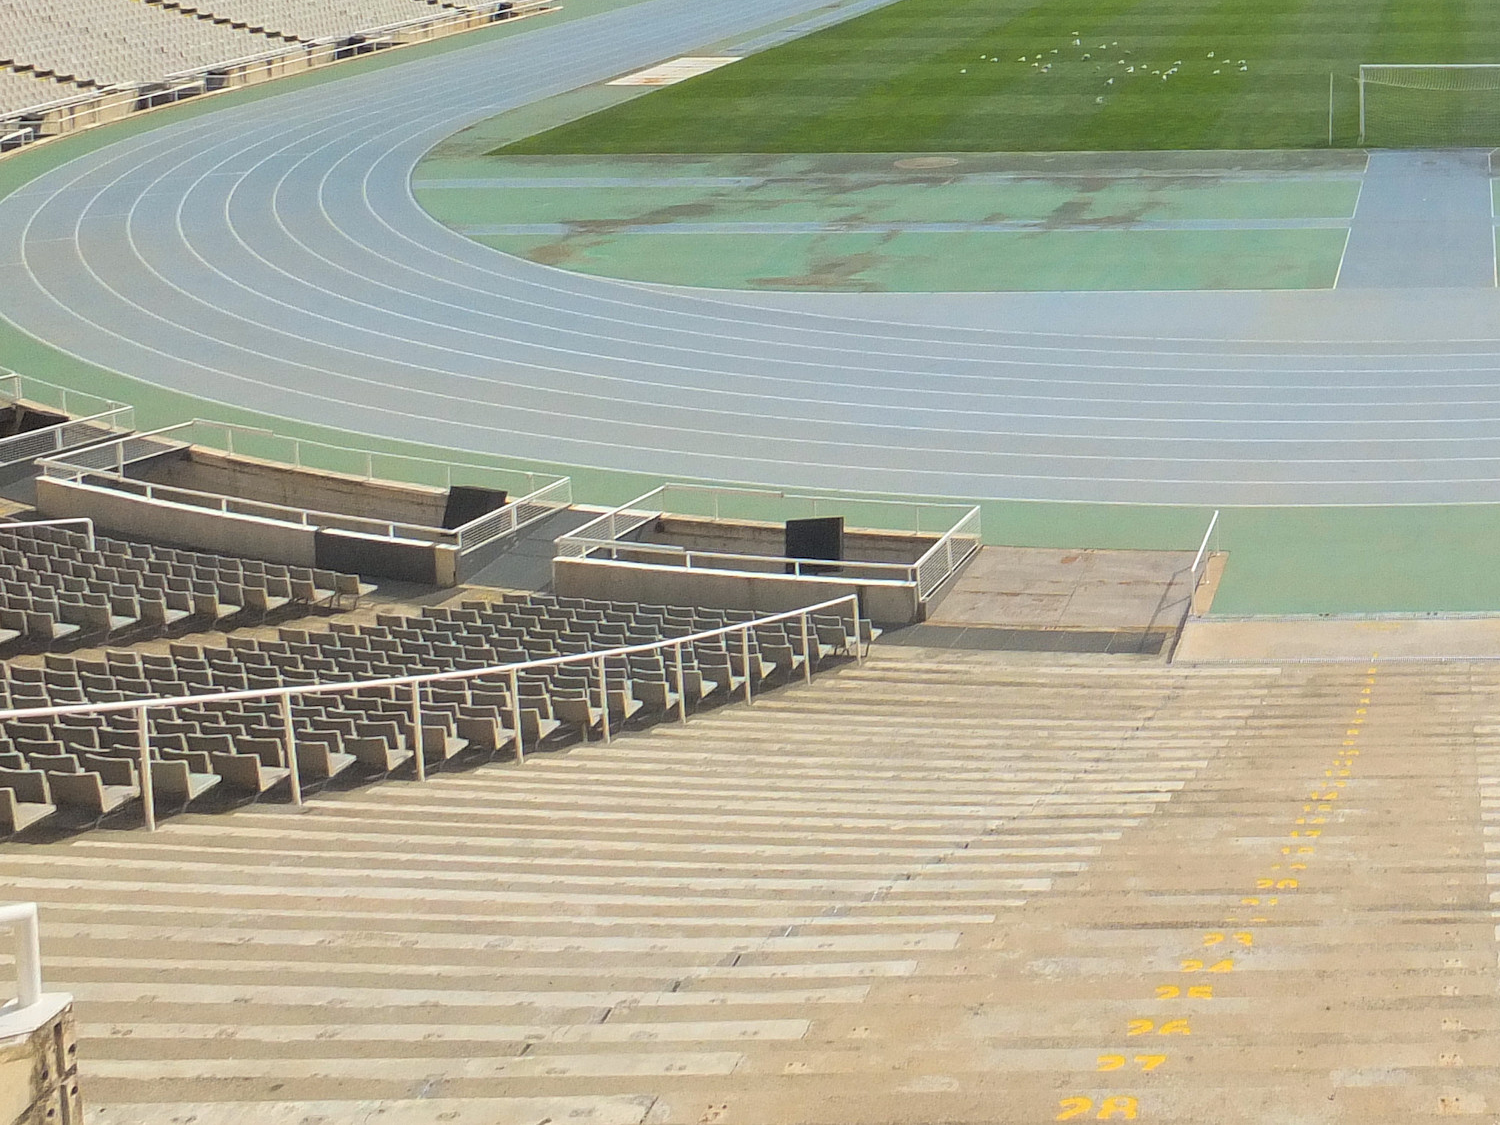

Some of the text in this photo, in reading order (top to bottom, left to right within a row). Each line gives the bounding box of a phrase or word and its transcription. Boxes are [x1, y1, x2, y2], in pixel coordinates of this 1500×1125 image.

[1181, 960, 1234, 973] 24
[1127, 1019, 1191, 1036] 26
[1096, 1054, 1167, 1072] 27
[1056, 1095, 1139, 1120] 28
